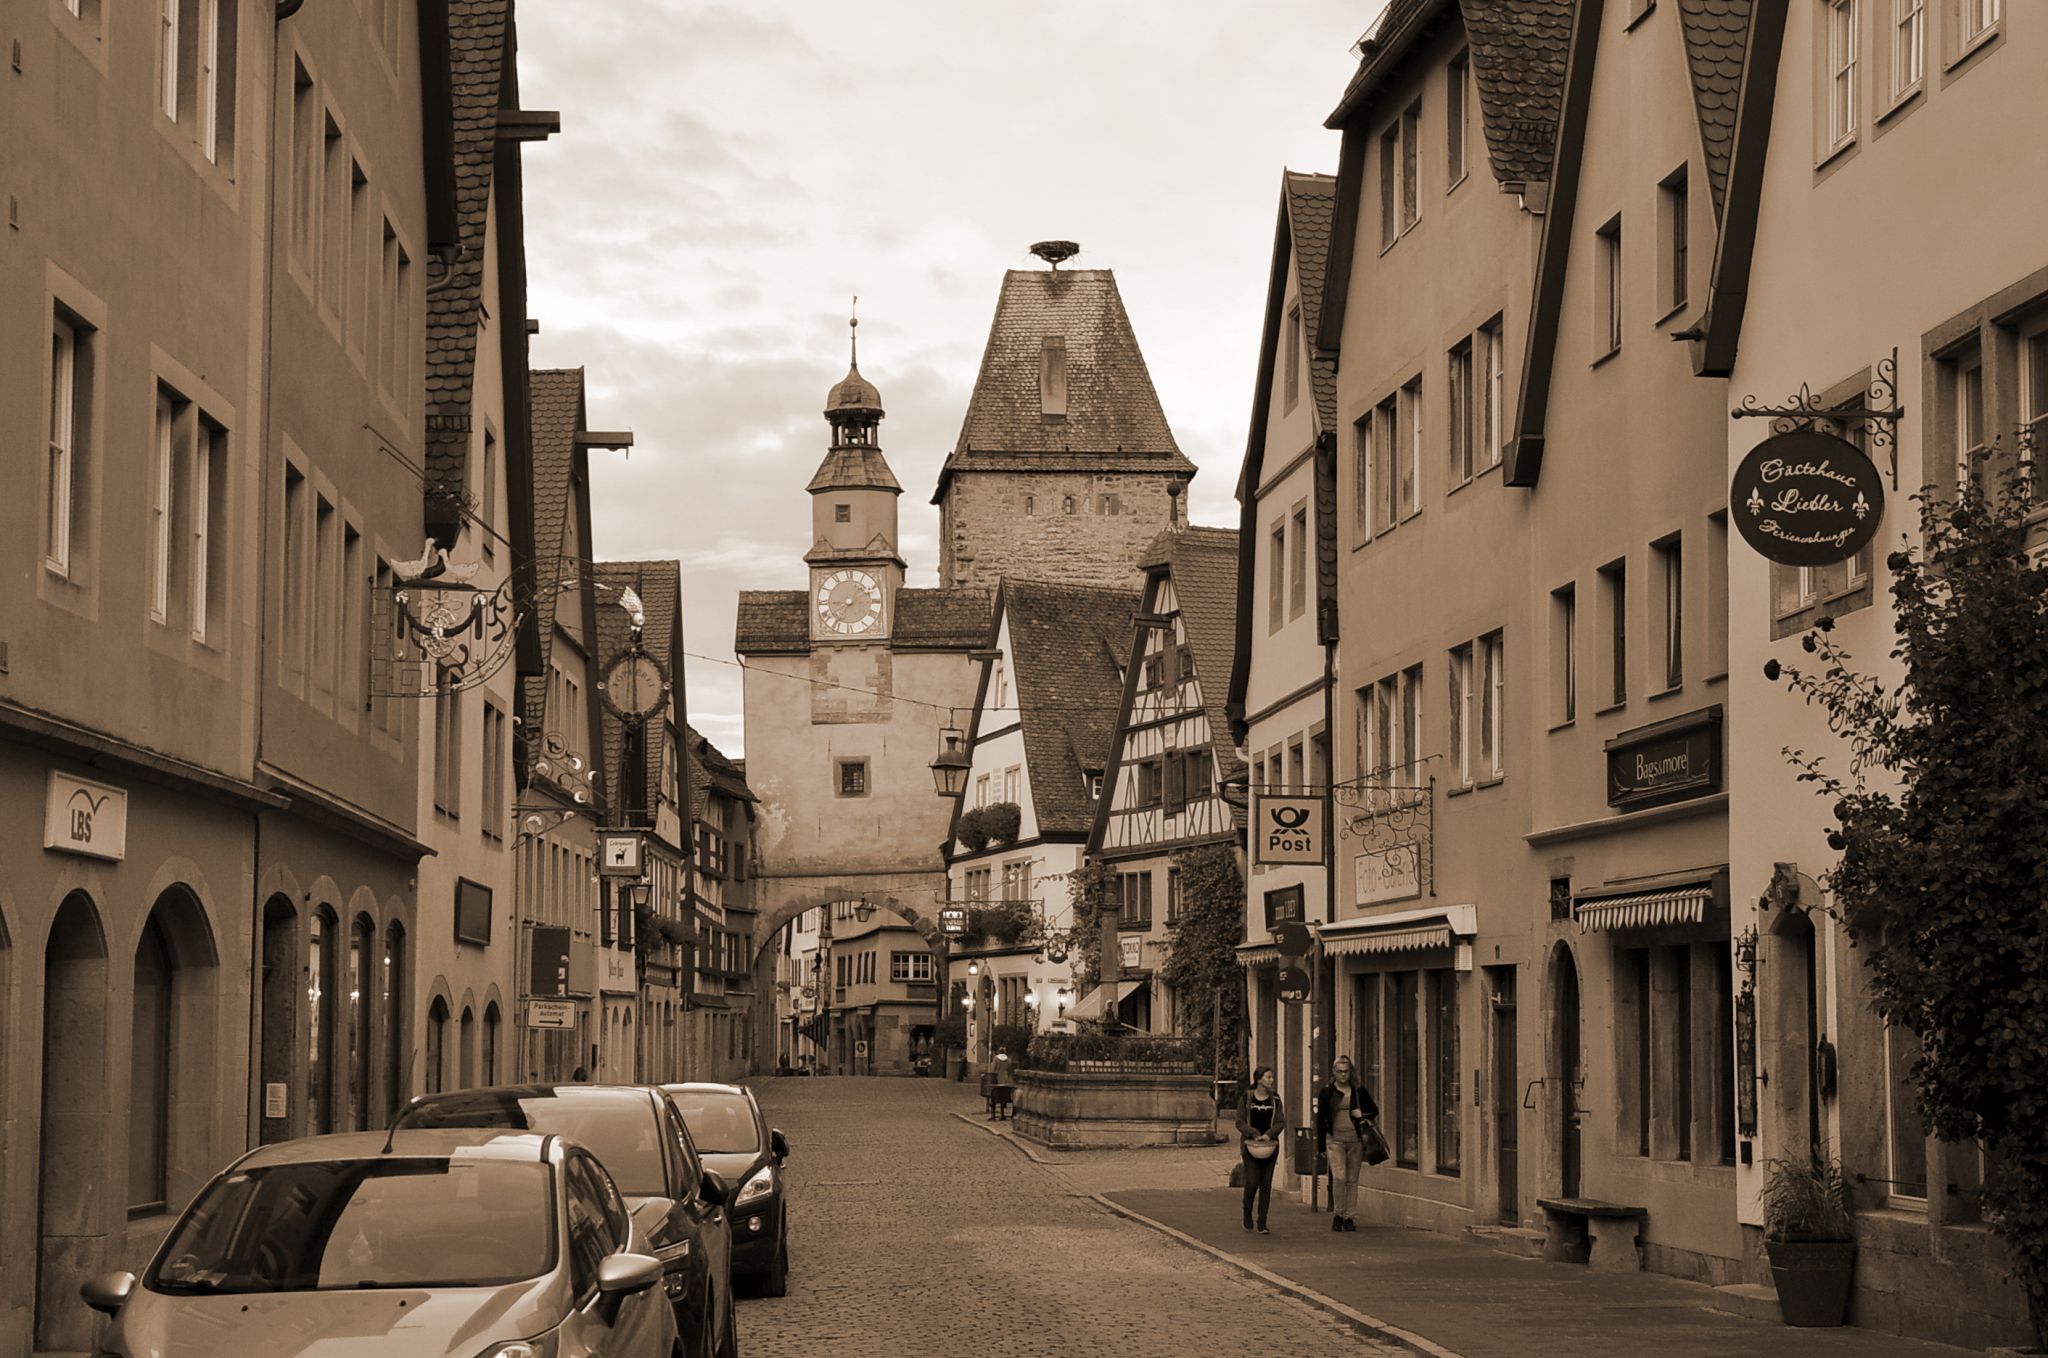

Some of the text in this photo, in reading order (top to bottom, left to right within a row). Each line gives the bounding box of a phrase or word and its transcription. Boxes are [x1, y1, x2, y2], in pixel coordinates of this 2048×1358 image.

[1759, 458, 1857, 487] Gästehaus
[1770, 488, 1844, 514] Liebler
[1758, 519, 1856, 548] Ferienwohnungen
[71, 808, 92, 844] LBS
[1269, 835, 1312, 852] Post
